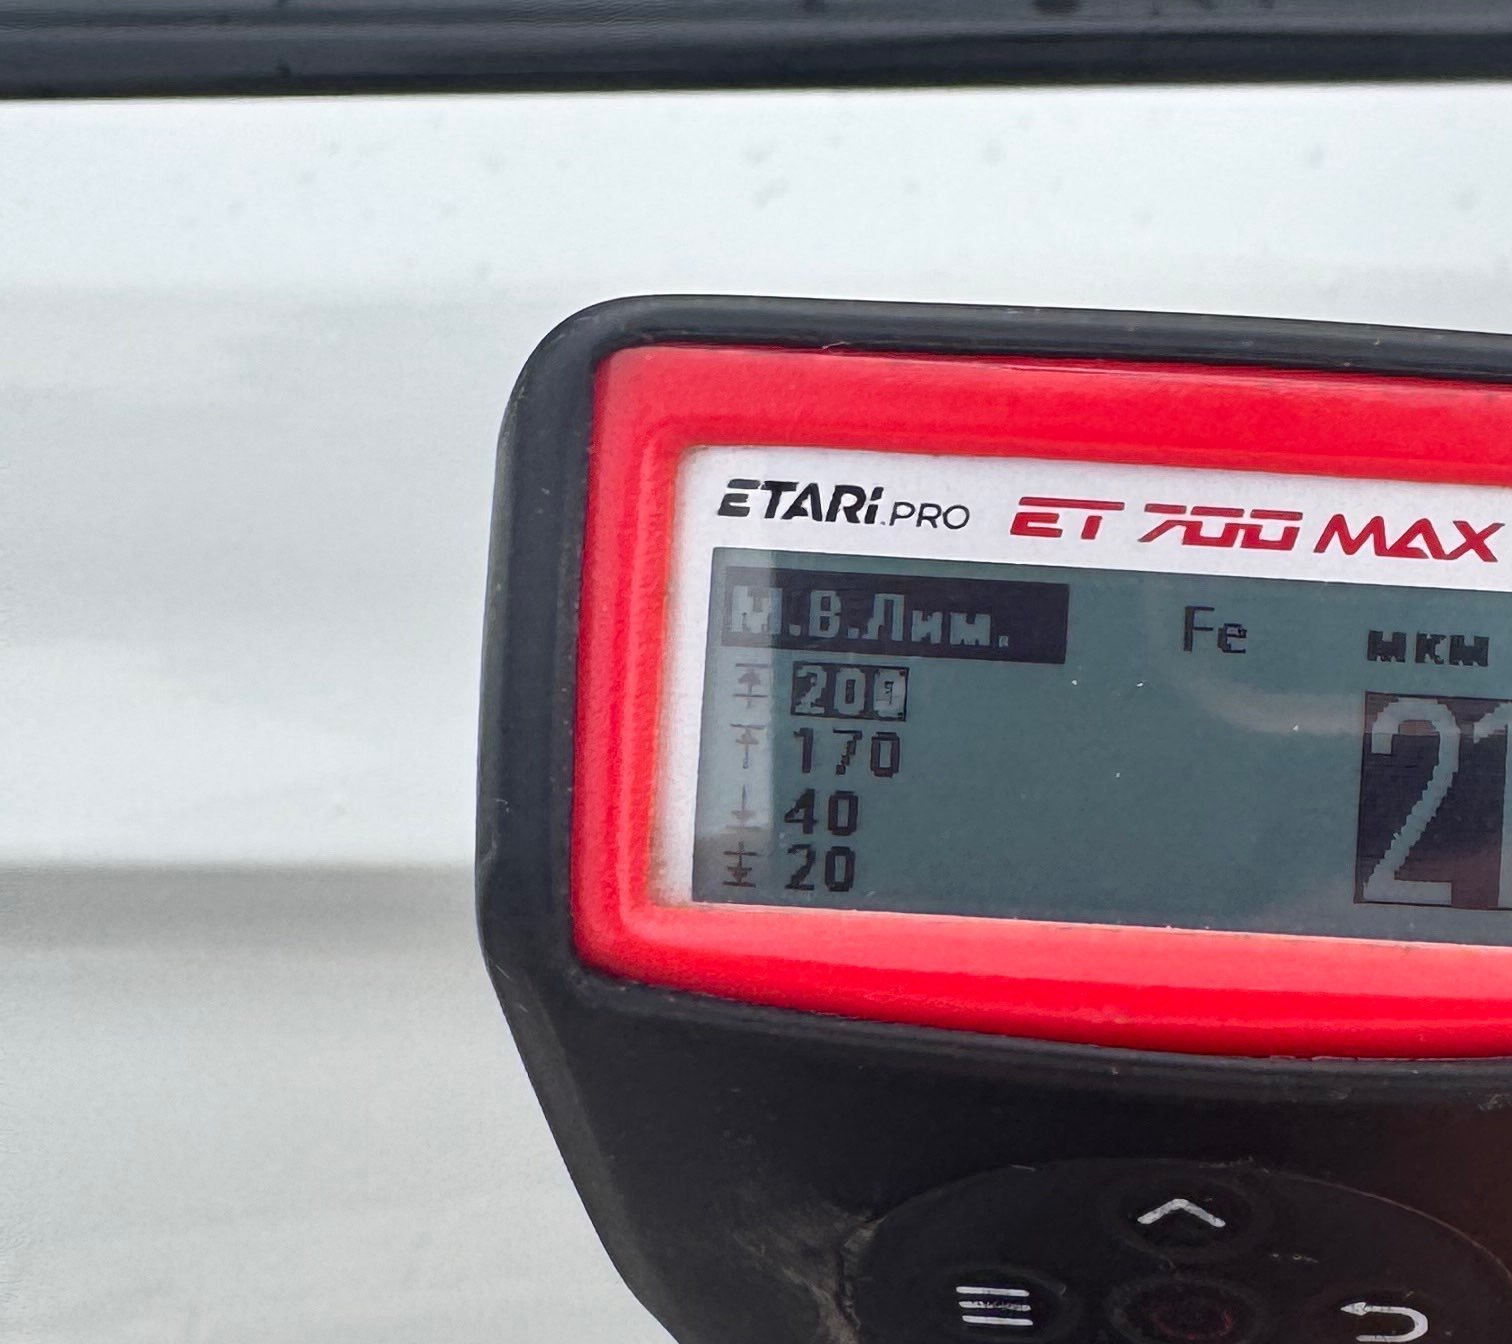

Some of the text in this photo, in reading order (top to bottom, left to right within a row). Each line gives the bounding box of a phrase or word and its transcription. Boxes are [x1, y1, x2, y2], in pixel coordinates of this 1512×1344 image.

[1009, 496, 1125, 541] ET
[1313, 513, 1506, 563] MAX
[1183, 605, 1249, 654] Fe
[793, 727, 901, 778] 170
[784, 788, 859, 836] 40
[783, 843, 856, 892] 20
